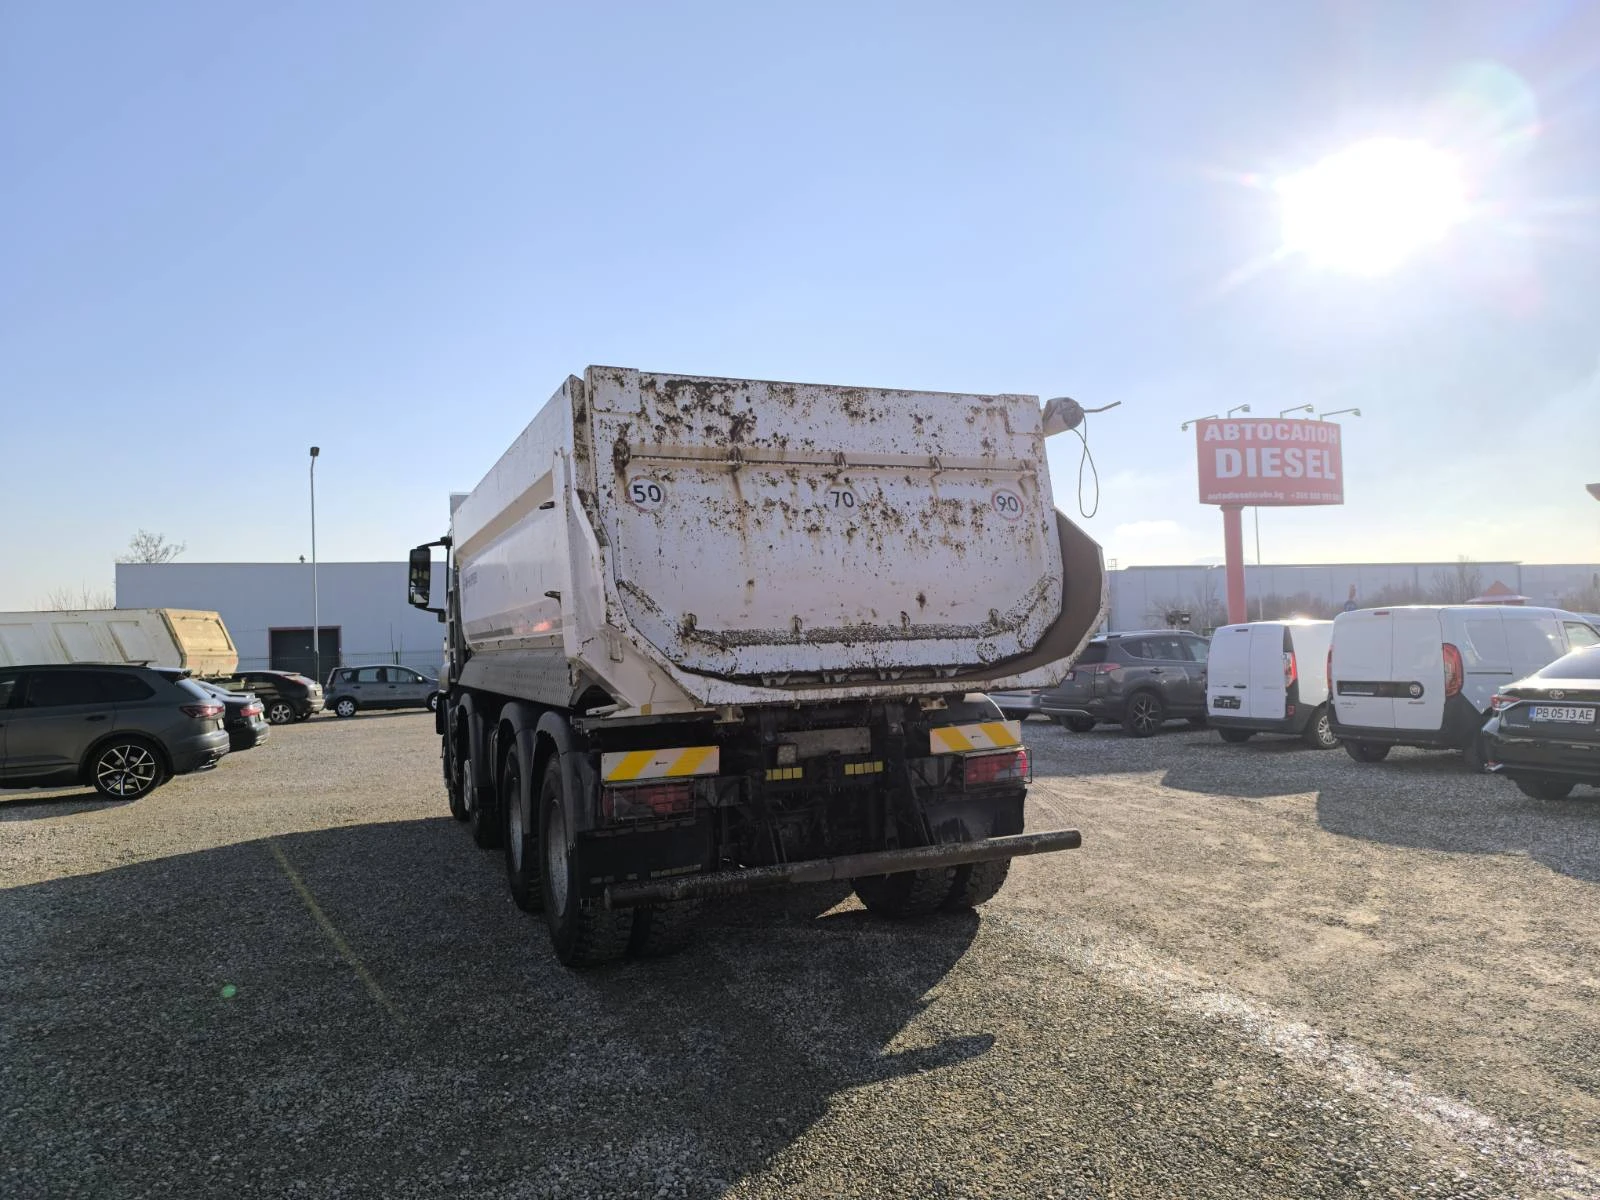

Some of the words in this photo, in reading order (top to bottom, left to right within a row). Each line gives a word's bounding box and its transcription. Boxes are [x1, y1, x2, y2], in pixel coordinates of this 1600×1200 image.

[1204, 422, 1338, 444] АВТОСАЛОН
[1215, 447, 1336, 480] DIESEL
[633, 484, 662, 503] 50
[830, 491, 854, 508] 70
[996, 495, 1018, 512] 90
[1535, 707, 1549, 718] PB
[1551, 708, 1576, 719] 0513
[1578, 709, 1593, 720] AE
